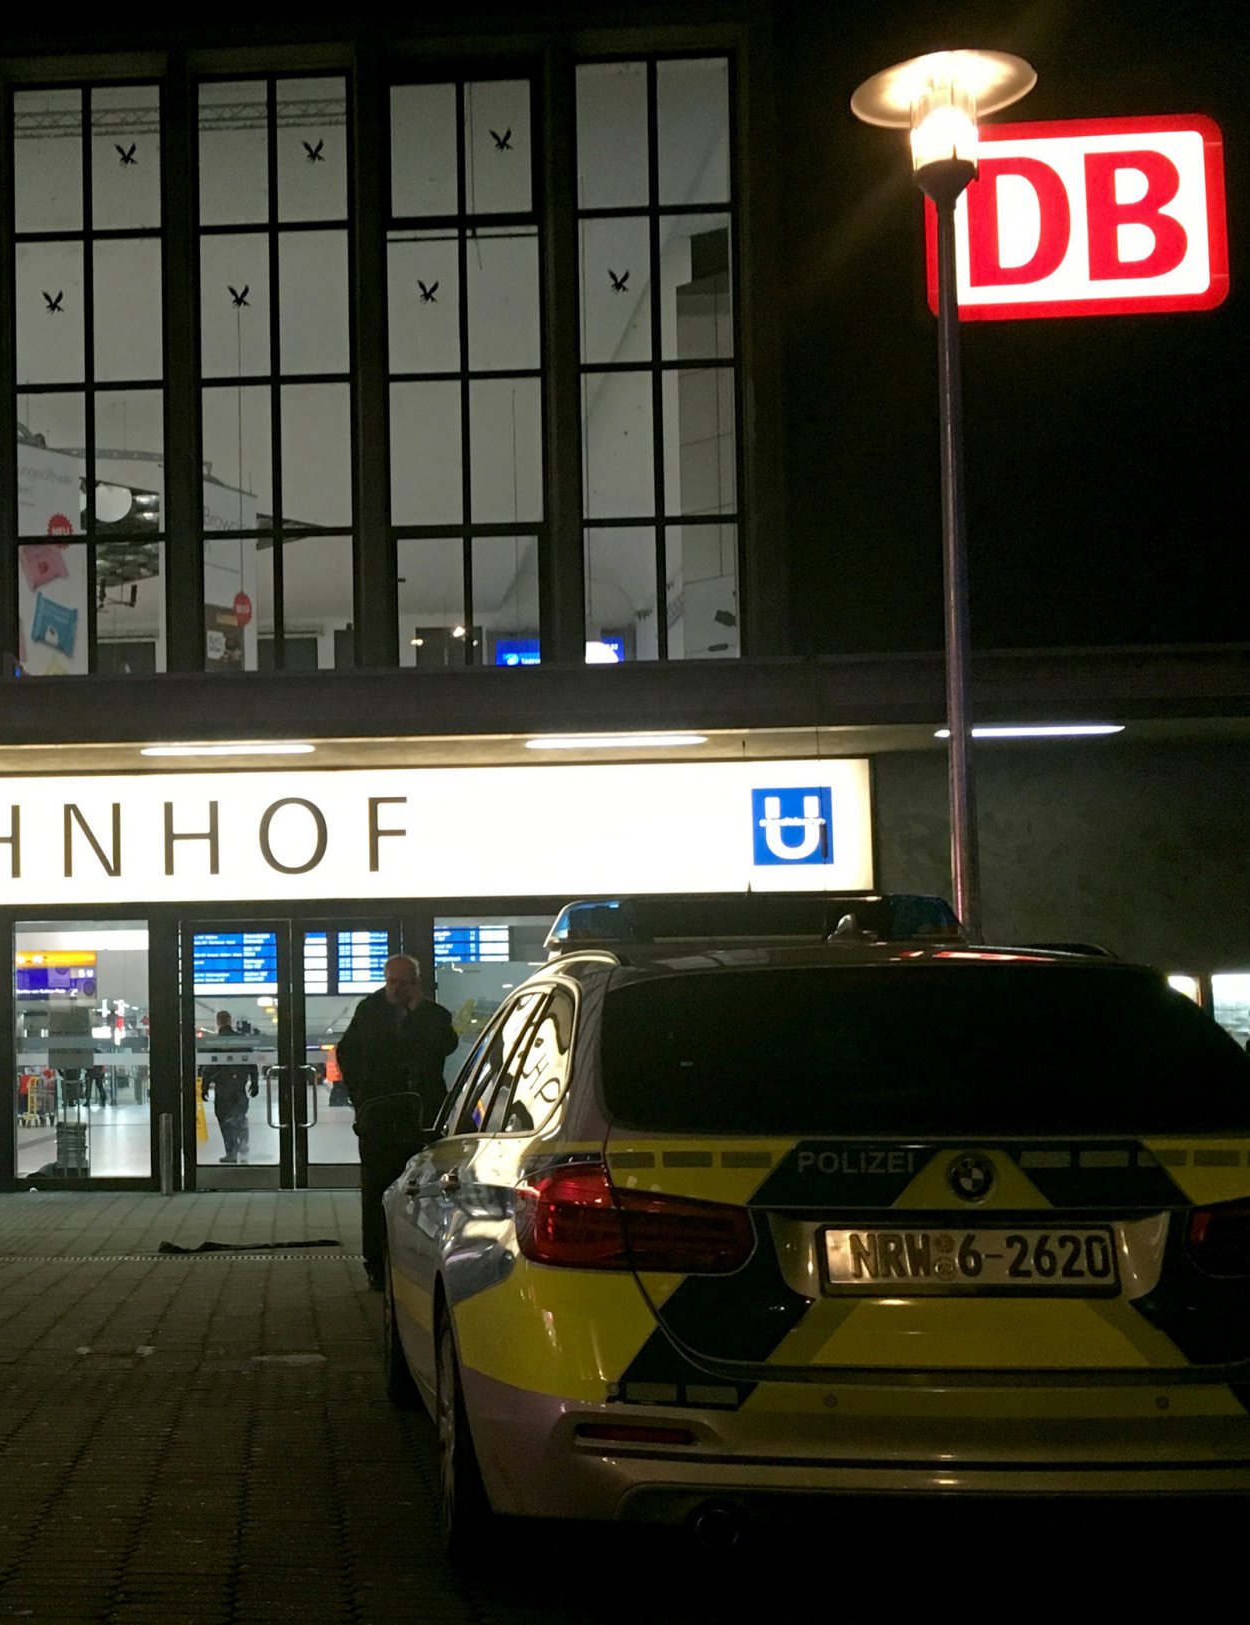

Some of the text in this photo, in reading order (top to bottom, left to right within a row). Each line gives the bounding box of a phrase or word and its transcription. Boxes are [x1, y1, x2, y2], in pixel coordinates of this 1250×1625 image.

[966, 150, 1187, 287] DB
[797, 1150, 914, 1174] POLIZEI
[848, 1233, 1111, 1279] NRW 6-2620
